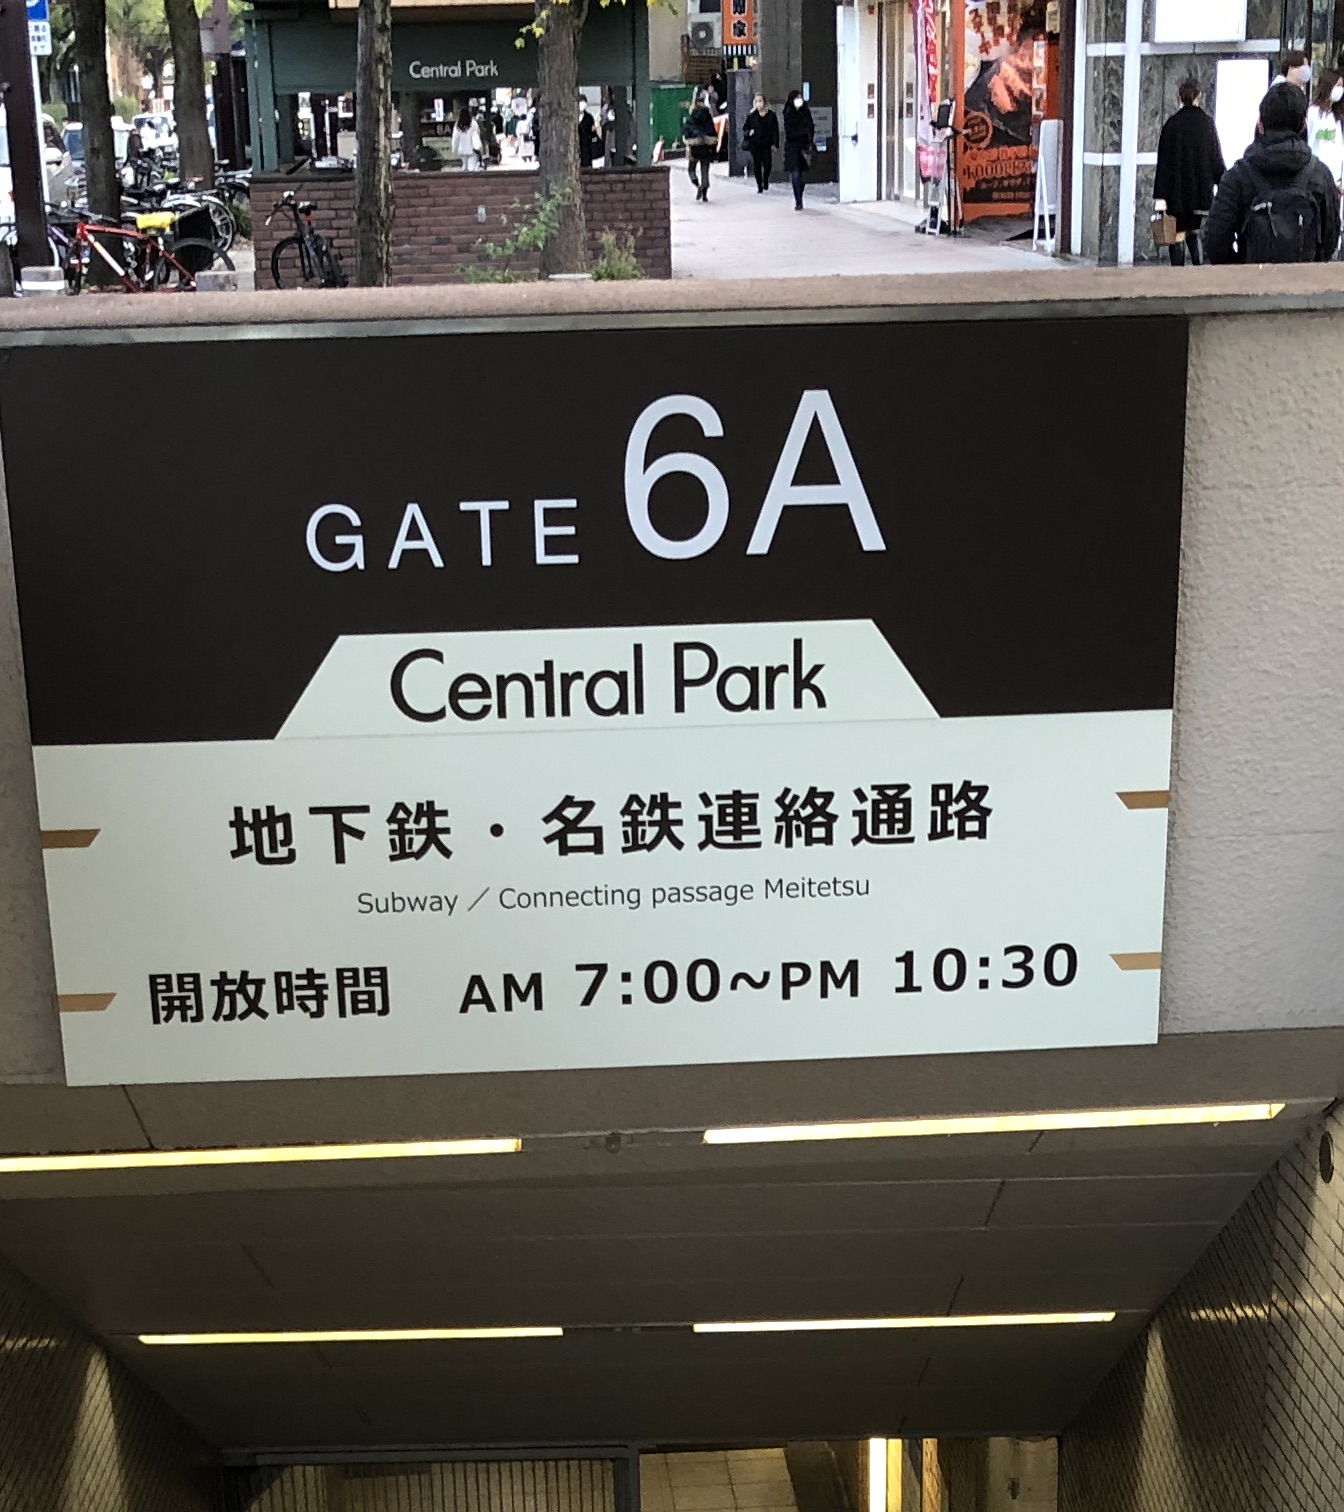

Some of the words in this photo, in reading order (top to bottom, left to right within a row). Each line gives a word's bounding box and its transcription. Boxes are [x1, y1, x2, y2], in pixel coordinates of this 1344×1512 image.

[408, 60, 462, 79] Central
[465, 59, 499, 77] Park
[306, 498, 579, 572] GATE
[624, 389, 887, 560] 6A
[390, 643, 644, 723] Central
[673, 639, 827, 714] Park
[228, 779, 993, 866] 地下鉄・名鉄連絡通路
[357, 891, 459, 917] Subway
[498, 885, 641, 912] Connecting
[652, 884, 754, 909] passage
[764, 876, 870, 900] Meitetsu
[148, 966, 391, 1026] 開放時間
[458, 972, 544, 1015] AM
[895, 942, 1078, 994] 10:30
